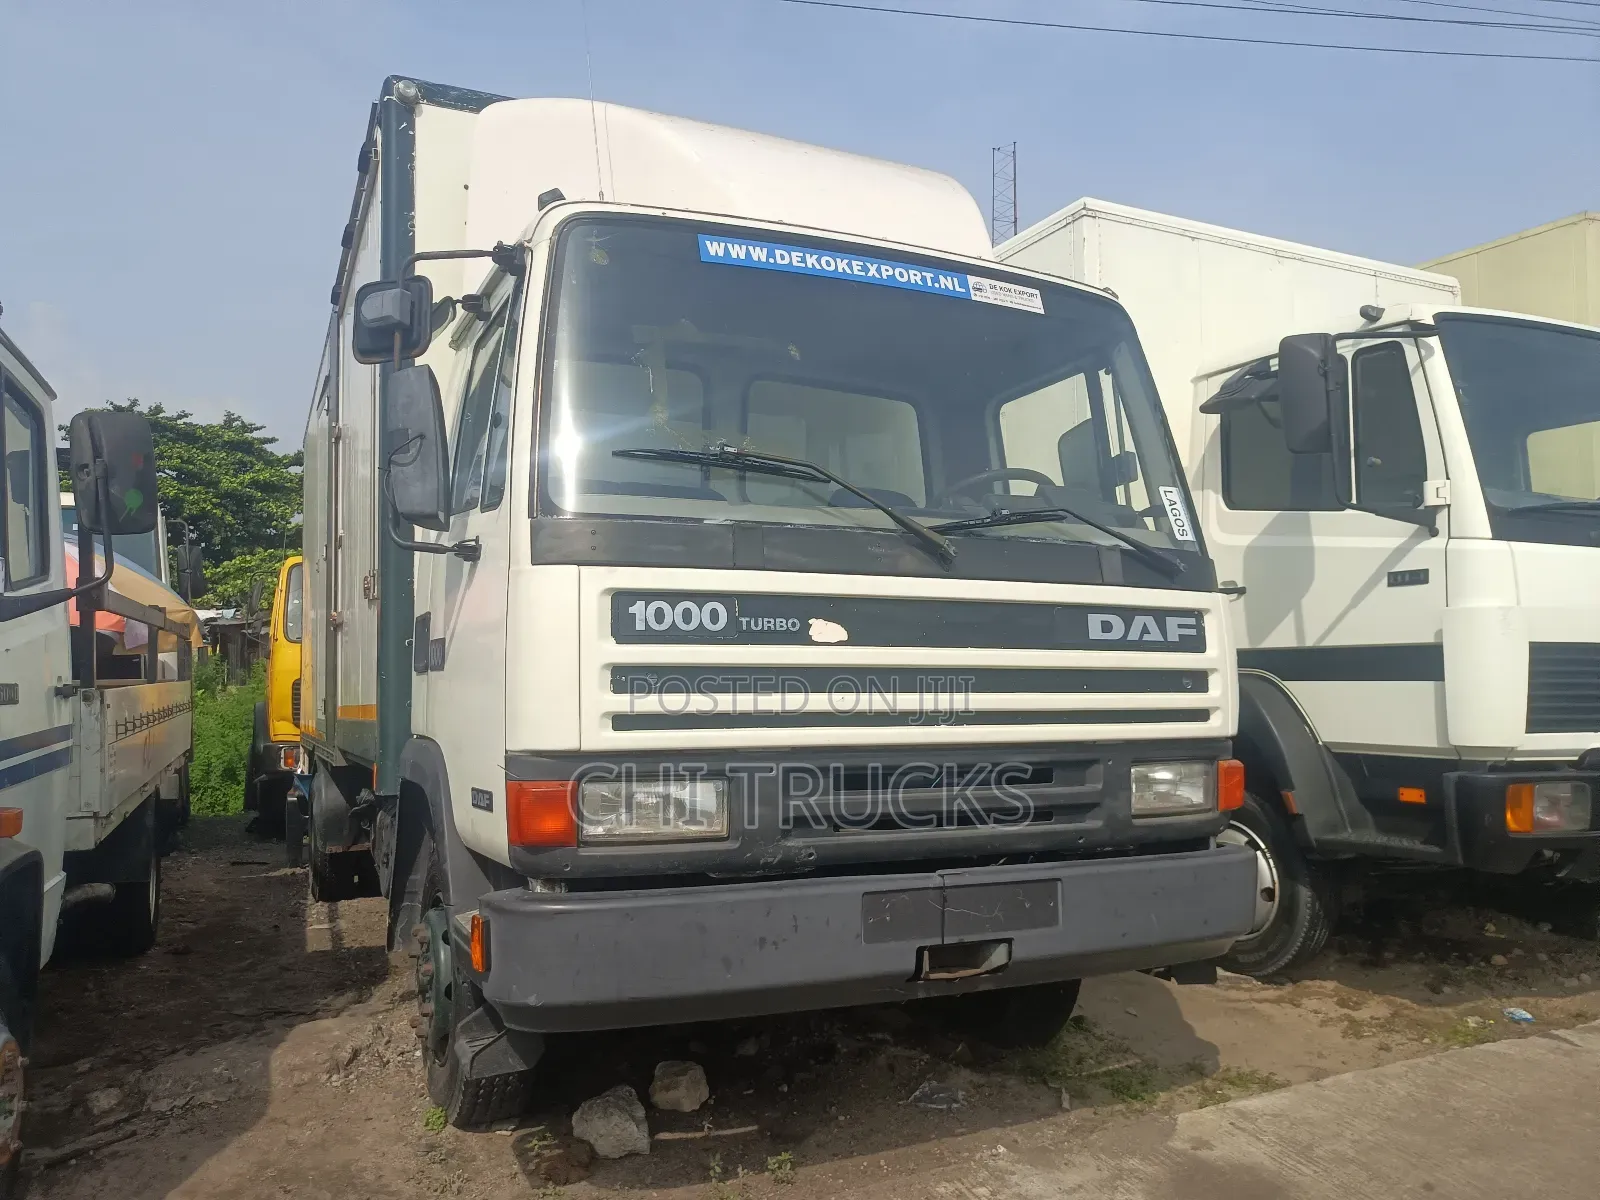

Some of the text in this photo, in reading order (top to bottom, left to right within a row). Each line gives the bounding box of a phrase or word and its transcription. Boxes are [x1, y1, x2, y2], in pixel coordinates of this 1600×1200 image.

[704, 240, 966, 293] WWW.DEKOKEXPORT.NL
[989, 283, 1038, 300] DE KOK EXPORT
[1163, 490, 1188, 537] LAGOS
[628, 600, 801, 632] 1000 TURBO
[1087, 613, 1197, 642] DAF
[472, 790, 490, 807] DAF
